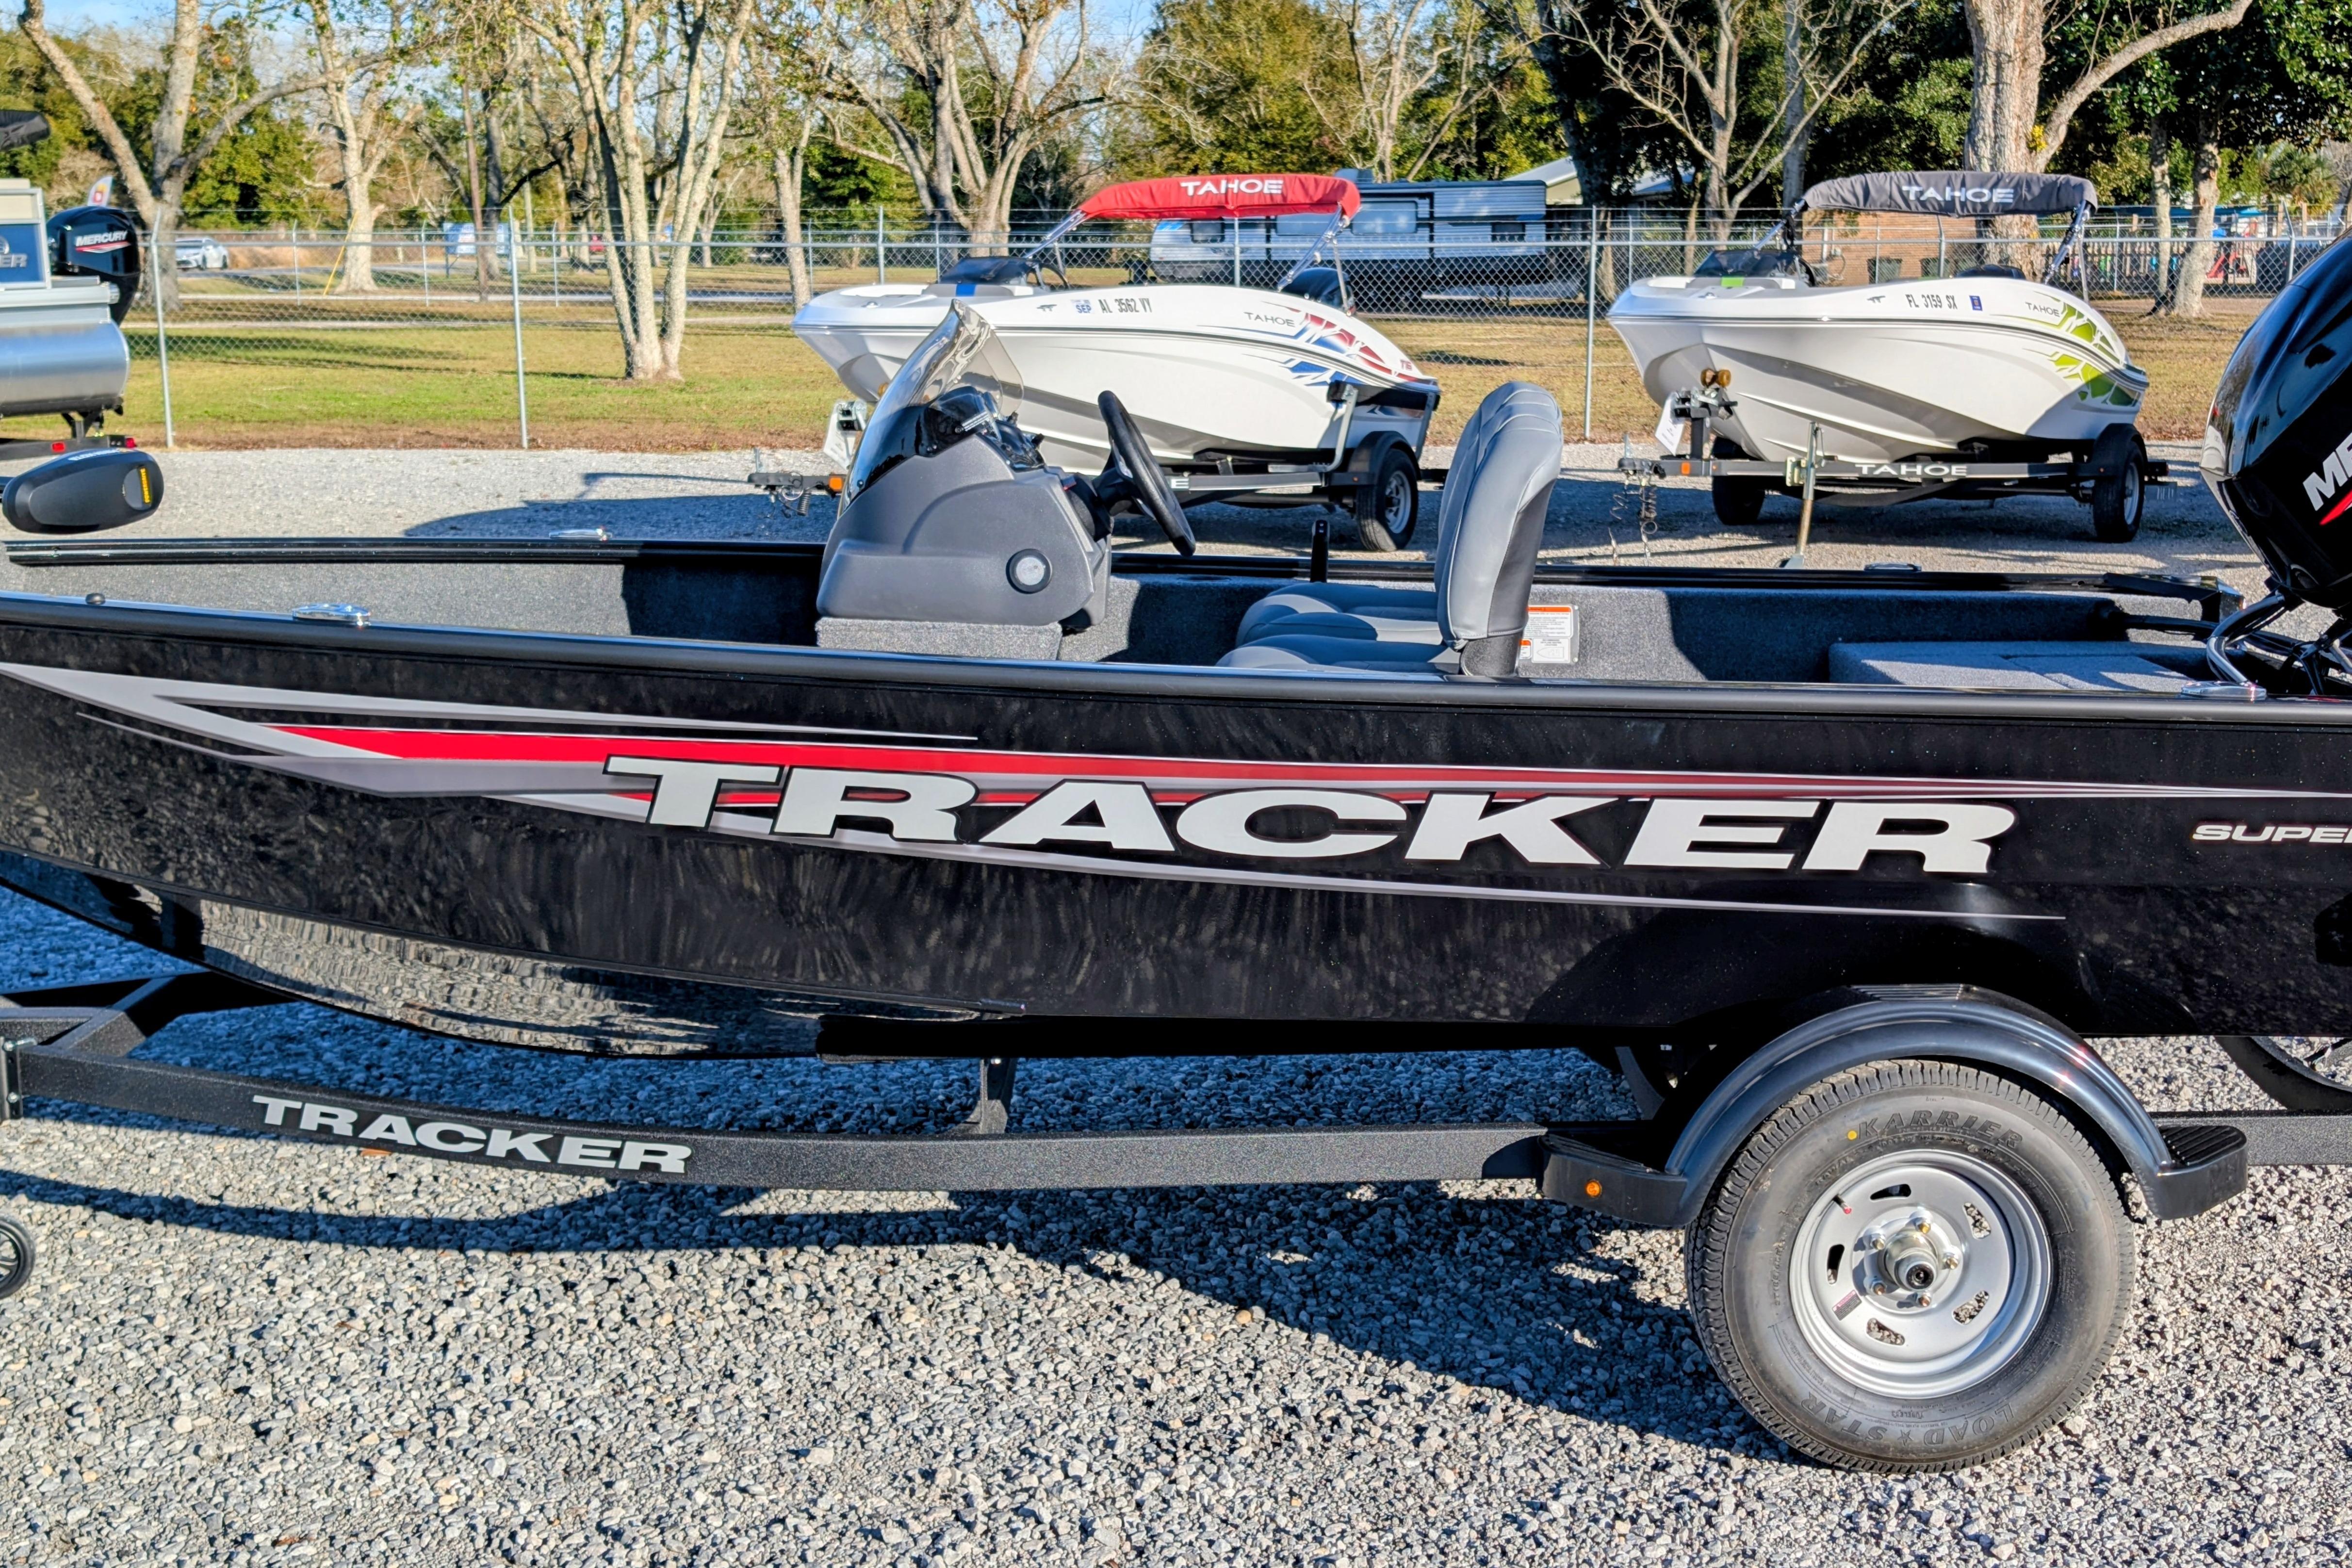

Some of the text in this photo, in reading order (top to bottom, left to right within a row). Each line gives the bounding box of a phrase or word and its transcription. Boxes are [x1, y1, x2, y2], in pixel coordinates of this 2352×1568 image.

[1180, 179, 1284, 196] TAHOE
[1902, 186, 2014, 203] TAHOE
[76, 230, 128, 246] MERCURY
[1076, 305, 1092, 313] SEP
[1098, 298, 1152, 313] AL 3562 VY
[1905, 294, 1919, 308] FL
[1921, 294, 1942, 309] 3159
[1945, 295, 1958, 310] SX
[2025, 301, 2060, 318] TAHOE
[1243, 311, 1295, 327] TAHOE
[1855, 464, 1967, 476] TAHOE
[605, 755, 2015, 875] TRACKER
[2192, 824, 2352, 843] SUPE
[253, 1095, 692, 1173] TRACKER
[1857, 1109, 2023, 1148] KARRIER
[1801, 1392, 2016, 1447] LOAD STAR
